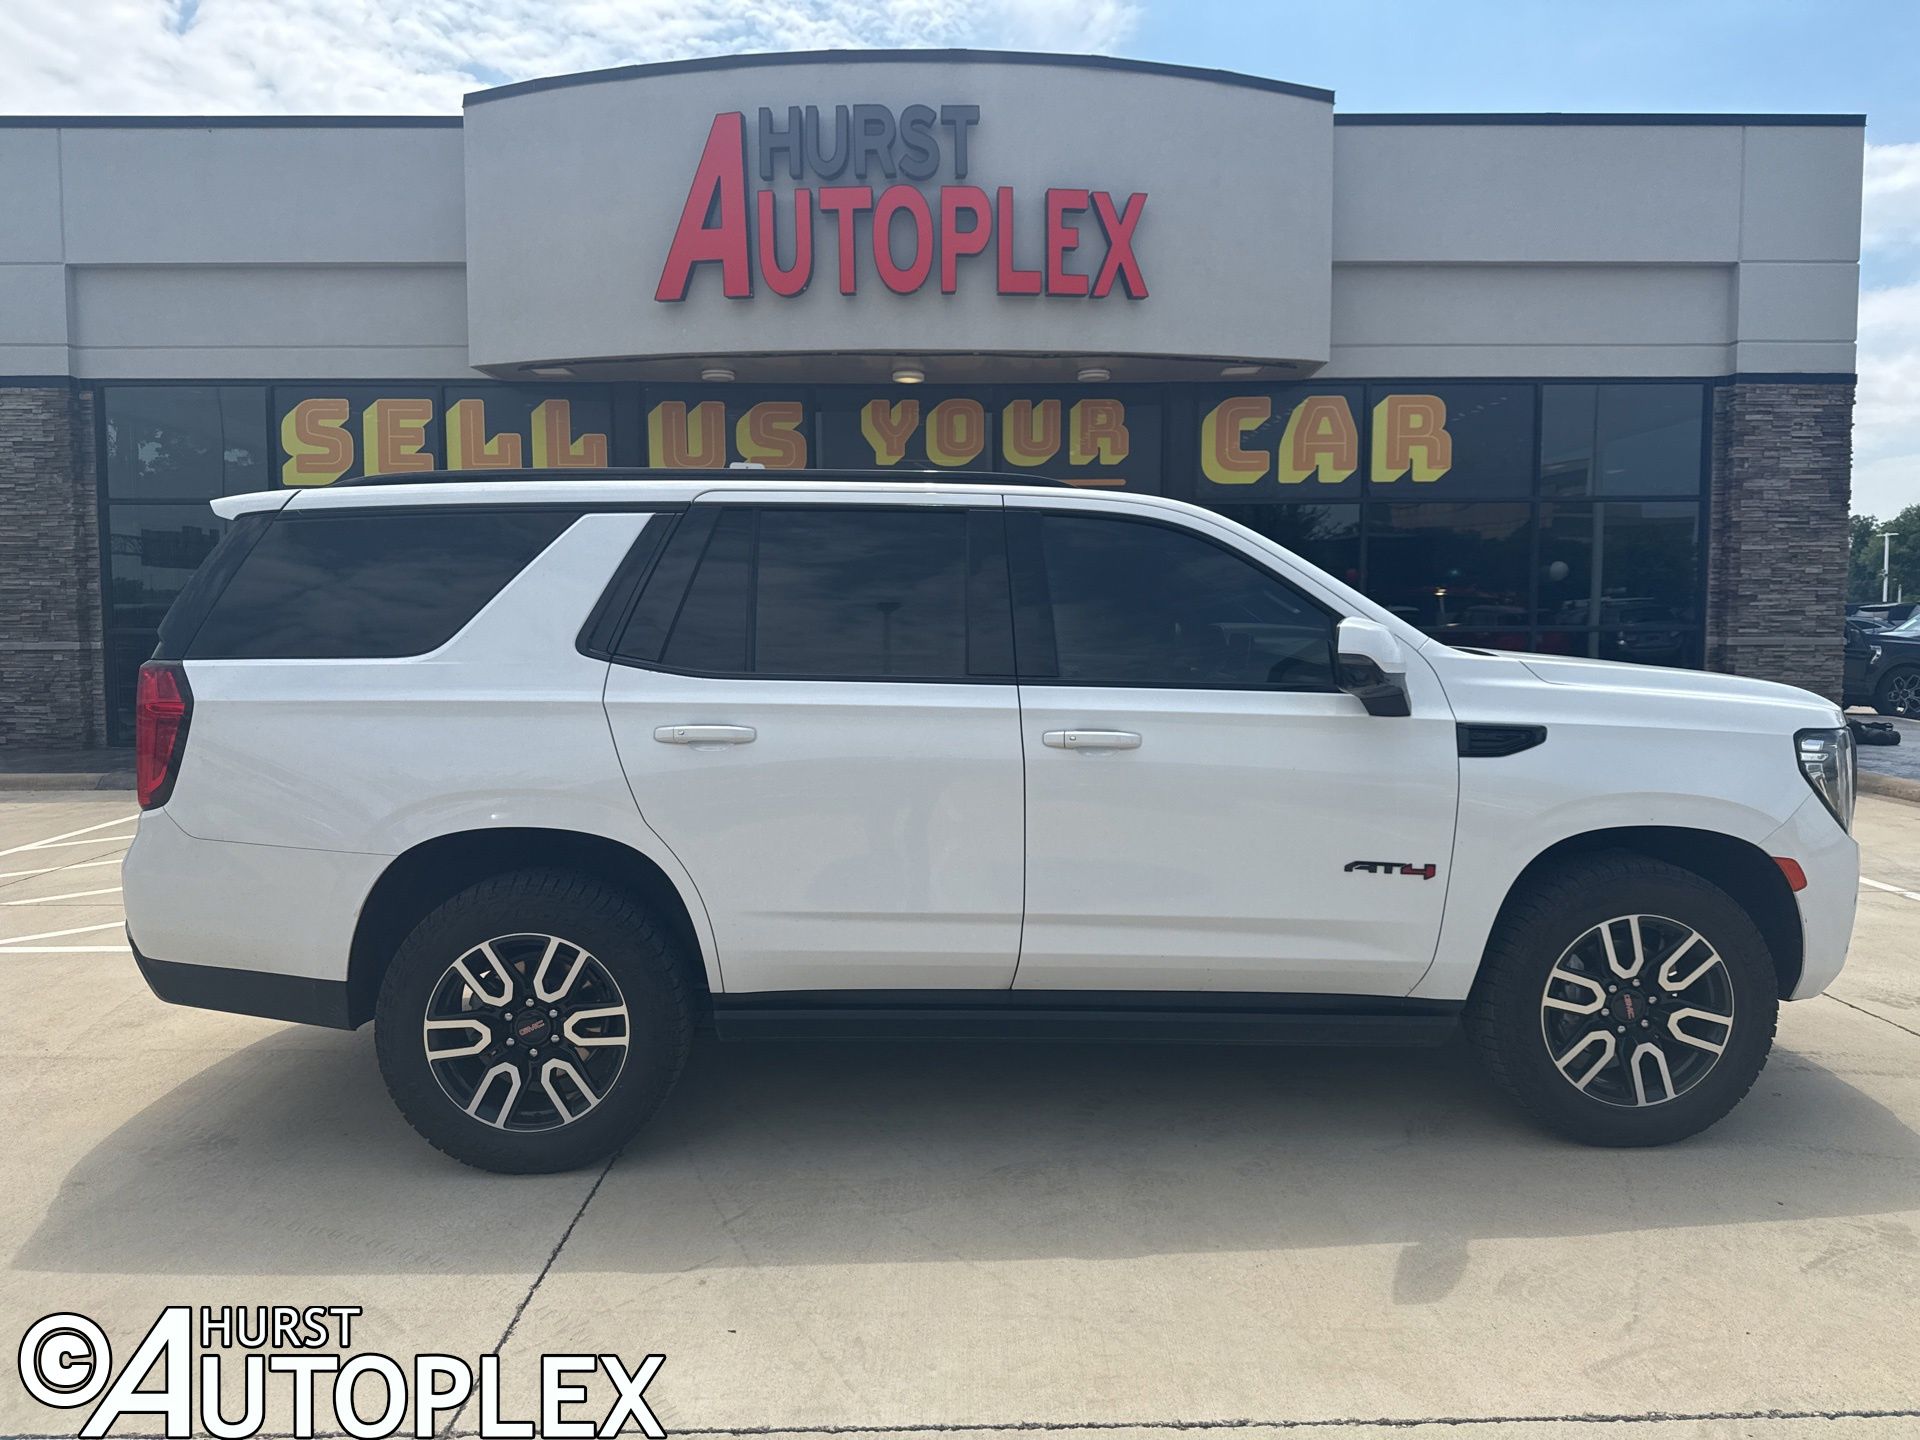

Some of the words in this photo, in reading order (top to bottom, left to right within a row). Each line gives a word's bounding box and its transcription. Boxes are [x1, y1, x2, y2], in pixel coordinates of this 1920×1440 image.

[758, 104, 980, 180] HURST
[654, 111, 1149, 302] AUTOPLEX
[281, 398, 608, 486] SELL
[647, 400, 808, 470] US
[861, 398, 1130, 467] YOUR
[1201, 394, 1453, 484] CAR
[1343, 860, 1436, 881] AT4
